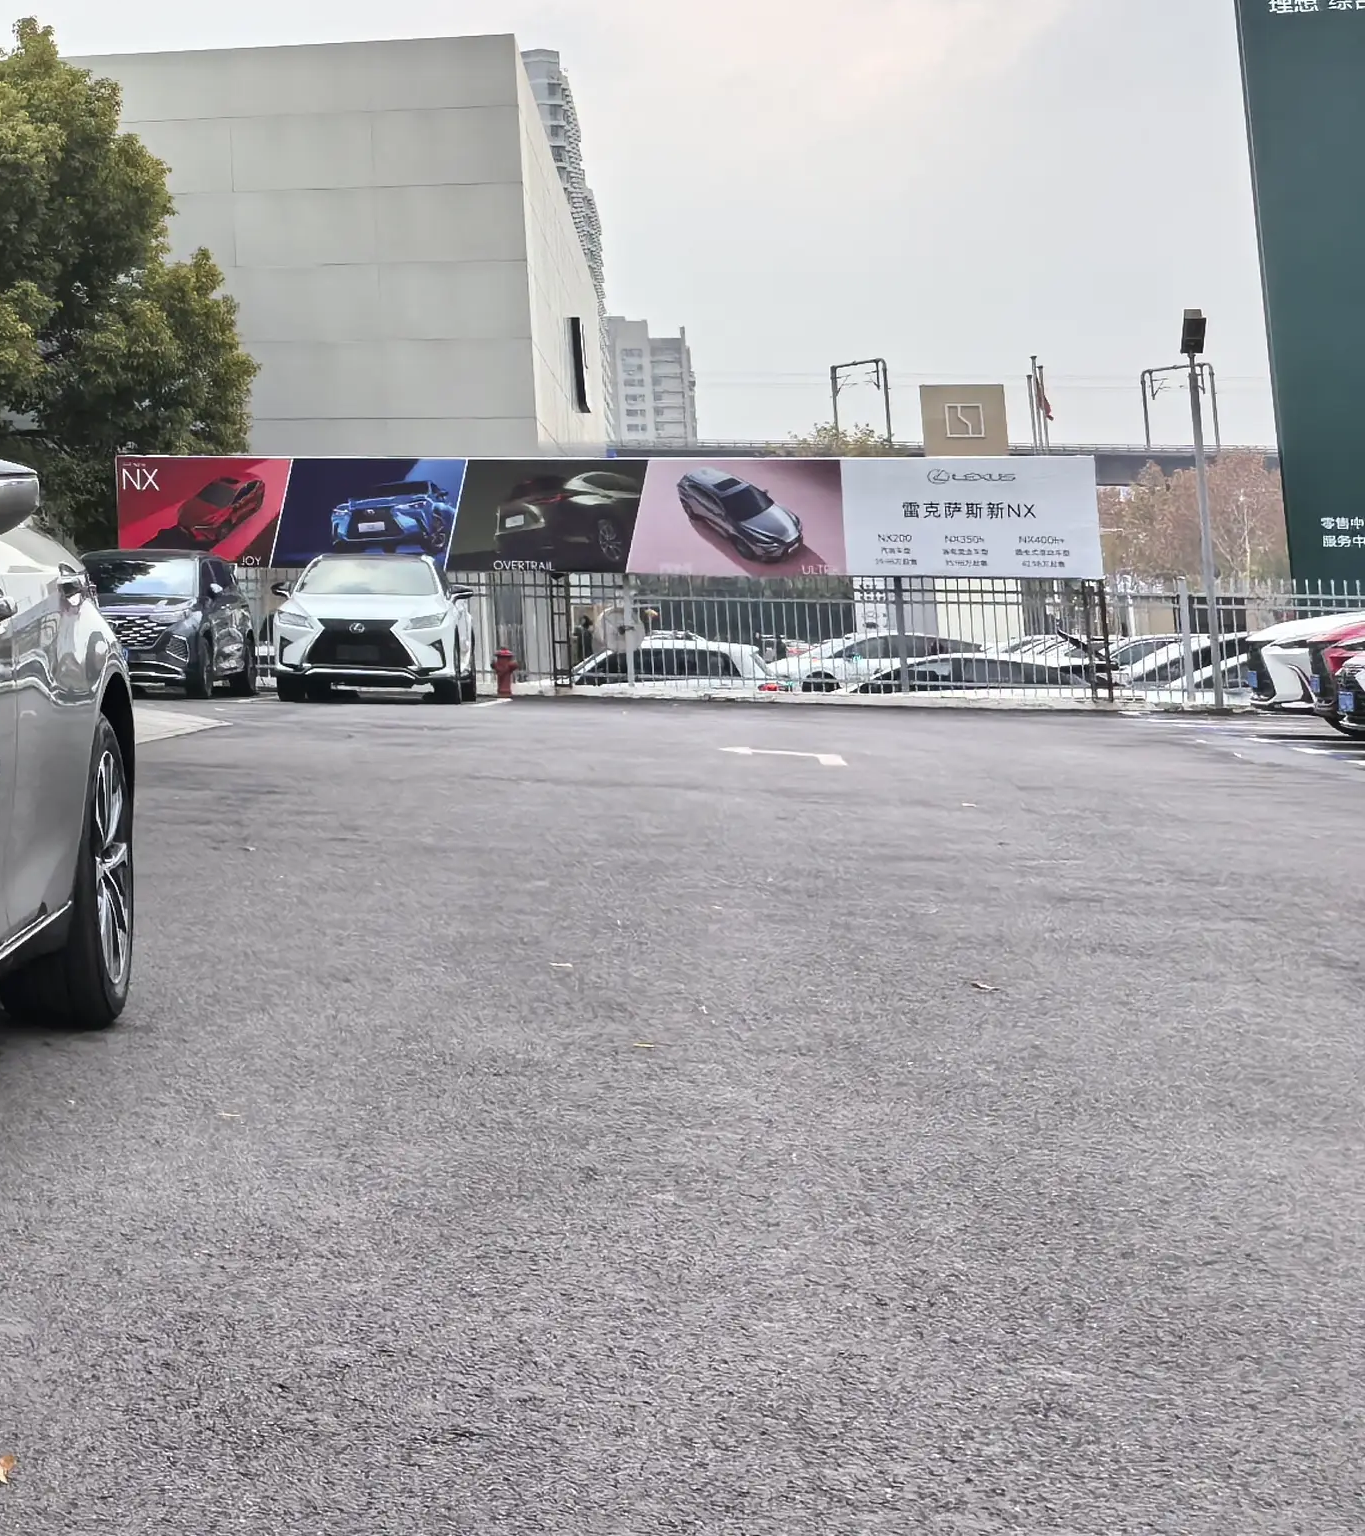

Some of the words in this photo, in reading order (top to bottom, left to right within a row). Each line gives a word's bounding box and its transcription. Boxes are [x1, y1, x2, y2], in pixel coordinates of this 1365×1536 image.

[122, 468, 159, 491] NX
[952, 473, 1016, 481] LEXUS
[902, 502, 1036, 519] 雷克萨斯新NX
[493, 560, 557, 571] OVERTRAIL
